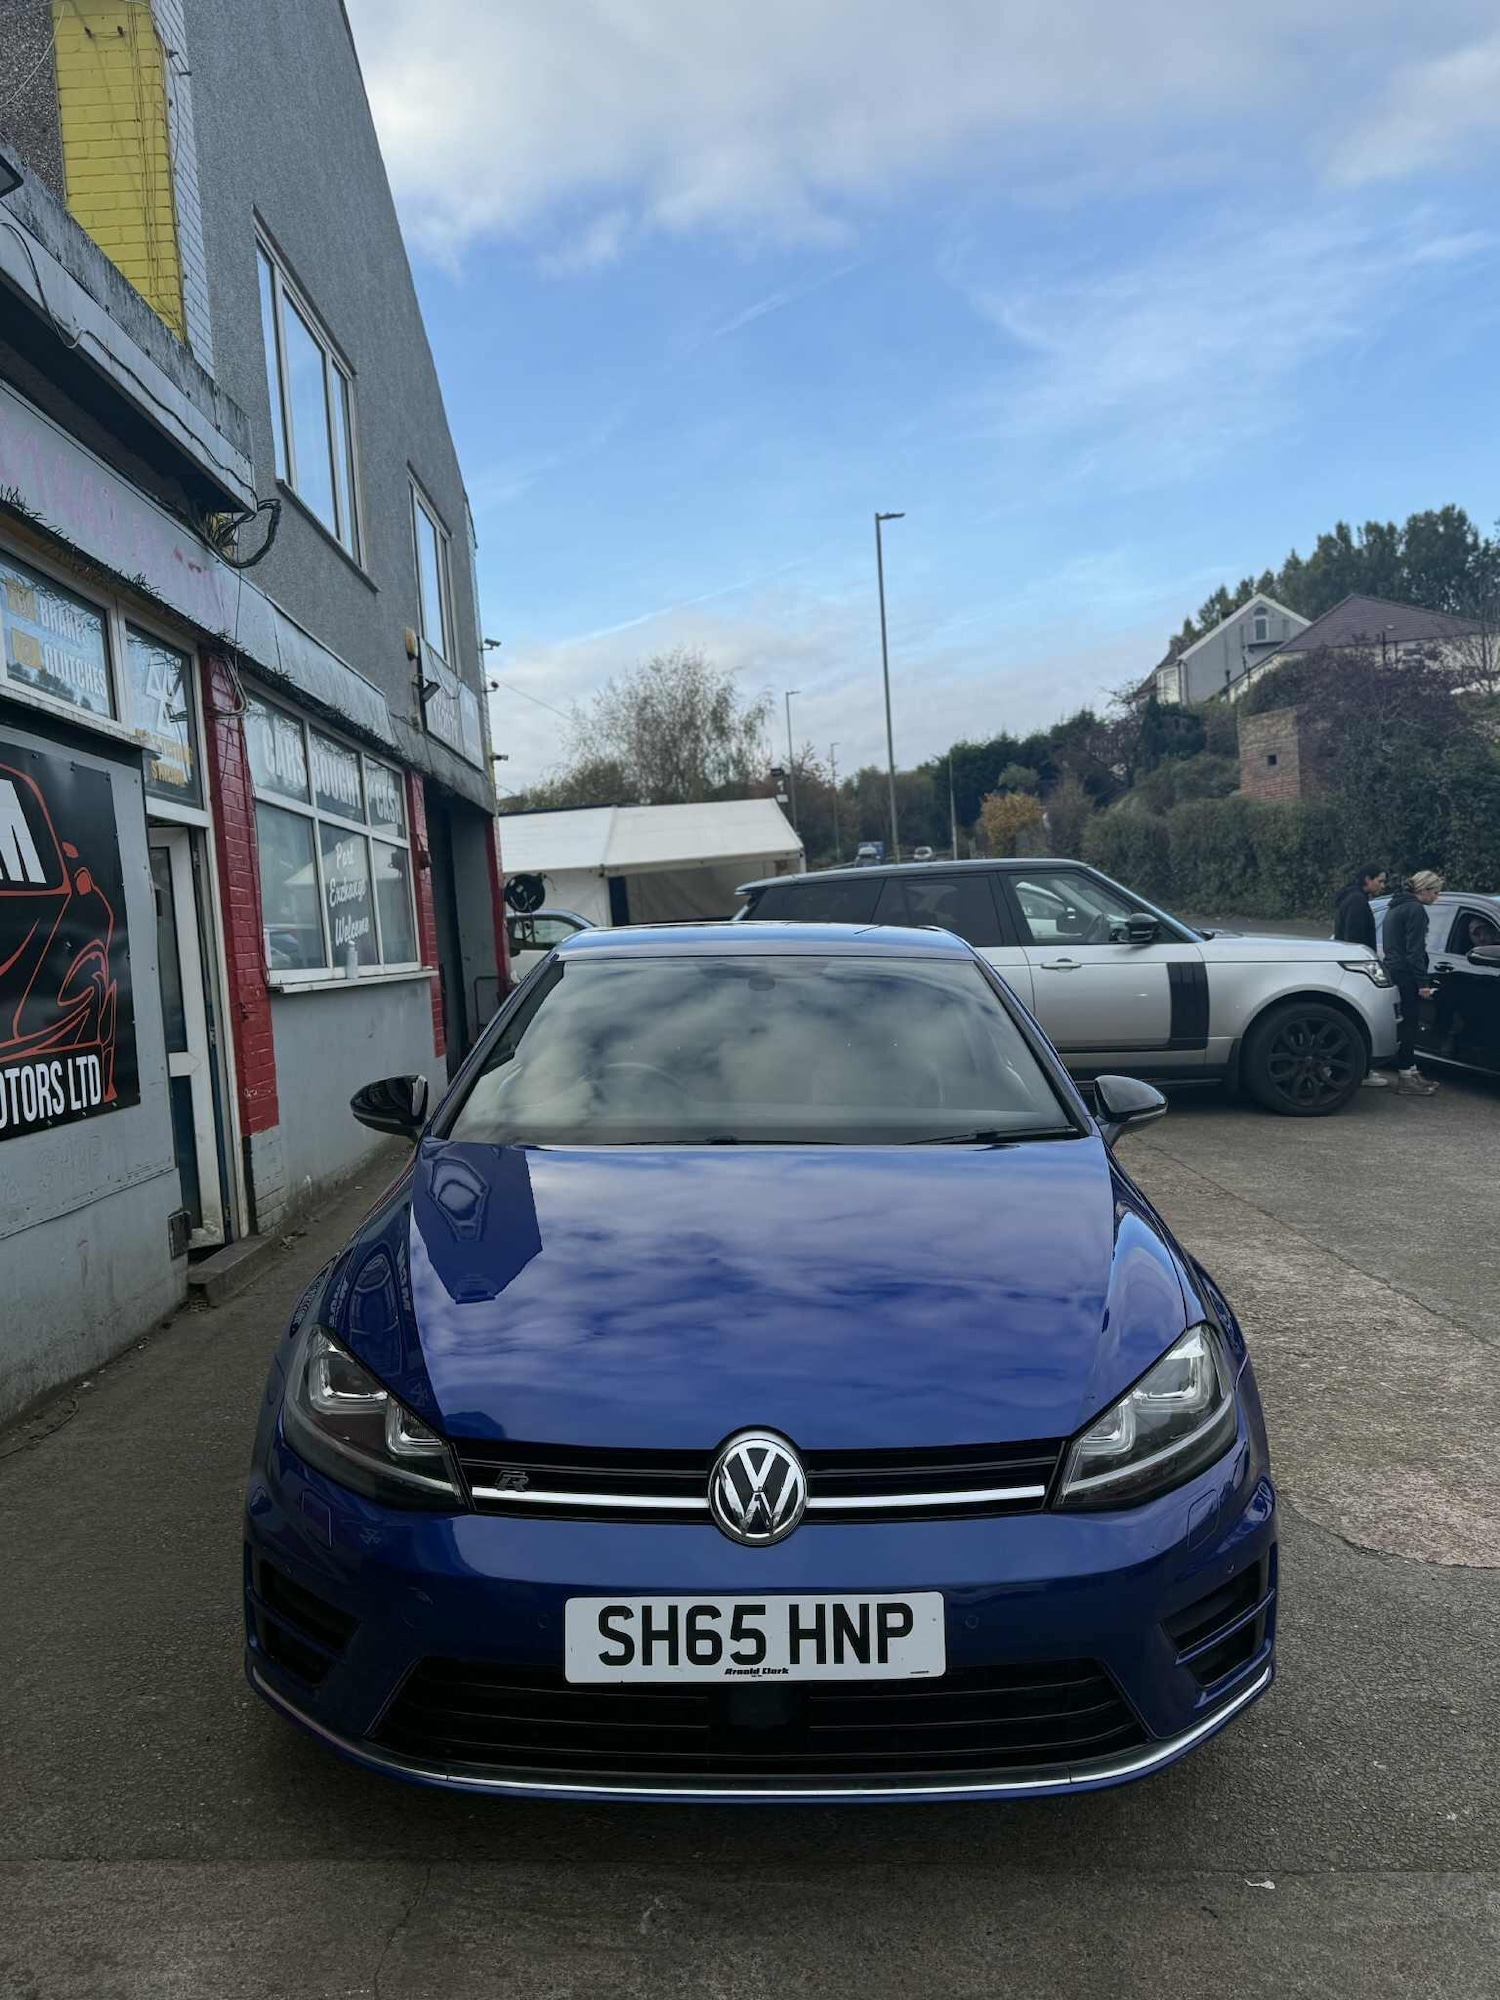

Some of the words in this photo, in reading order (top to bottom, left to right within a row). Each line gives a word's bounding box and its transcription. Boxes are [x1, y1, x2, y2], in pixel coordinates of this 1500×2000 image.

[44, 643, 106, 698] CLUTCHES
[262, 727, 308, 788] CARS
[310, 751, 362, 810] BOUGHT
[374, 783, 402, 825] CASH
[335, 842, 354, 869] Part
[329, 877, 366, 907] Exchange
[335, 915, 369, 946] Welcome
[67, 1054, 102, 1111] LTD
[598, 1604, 767, 1667] SH65
[788, 1602, 914, 1664] HNP
